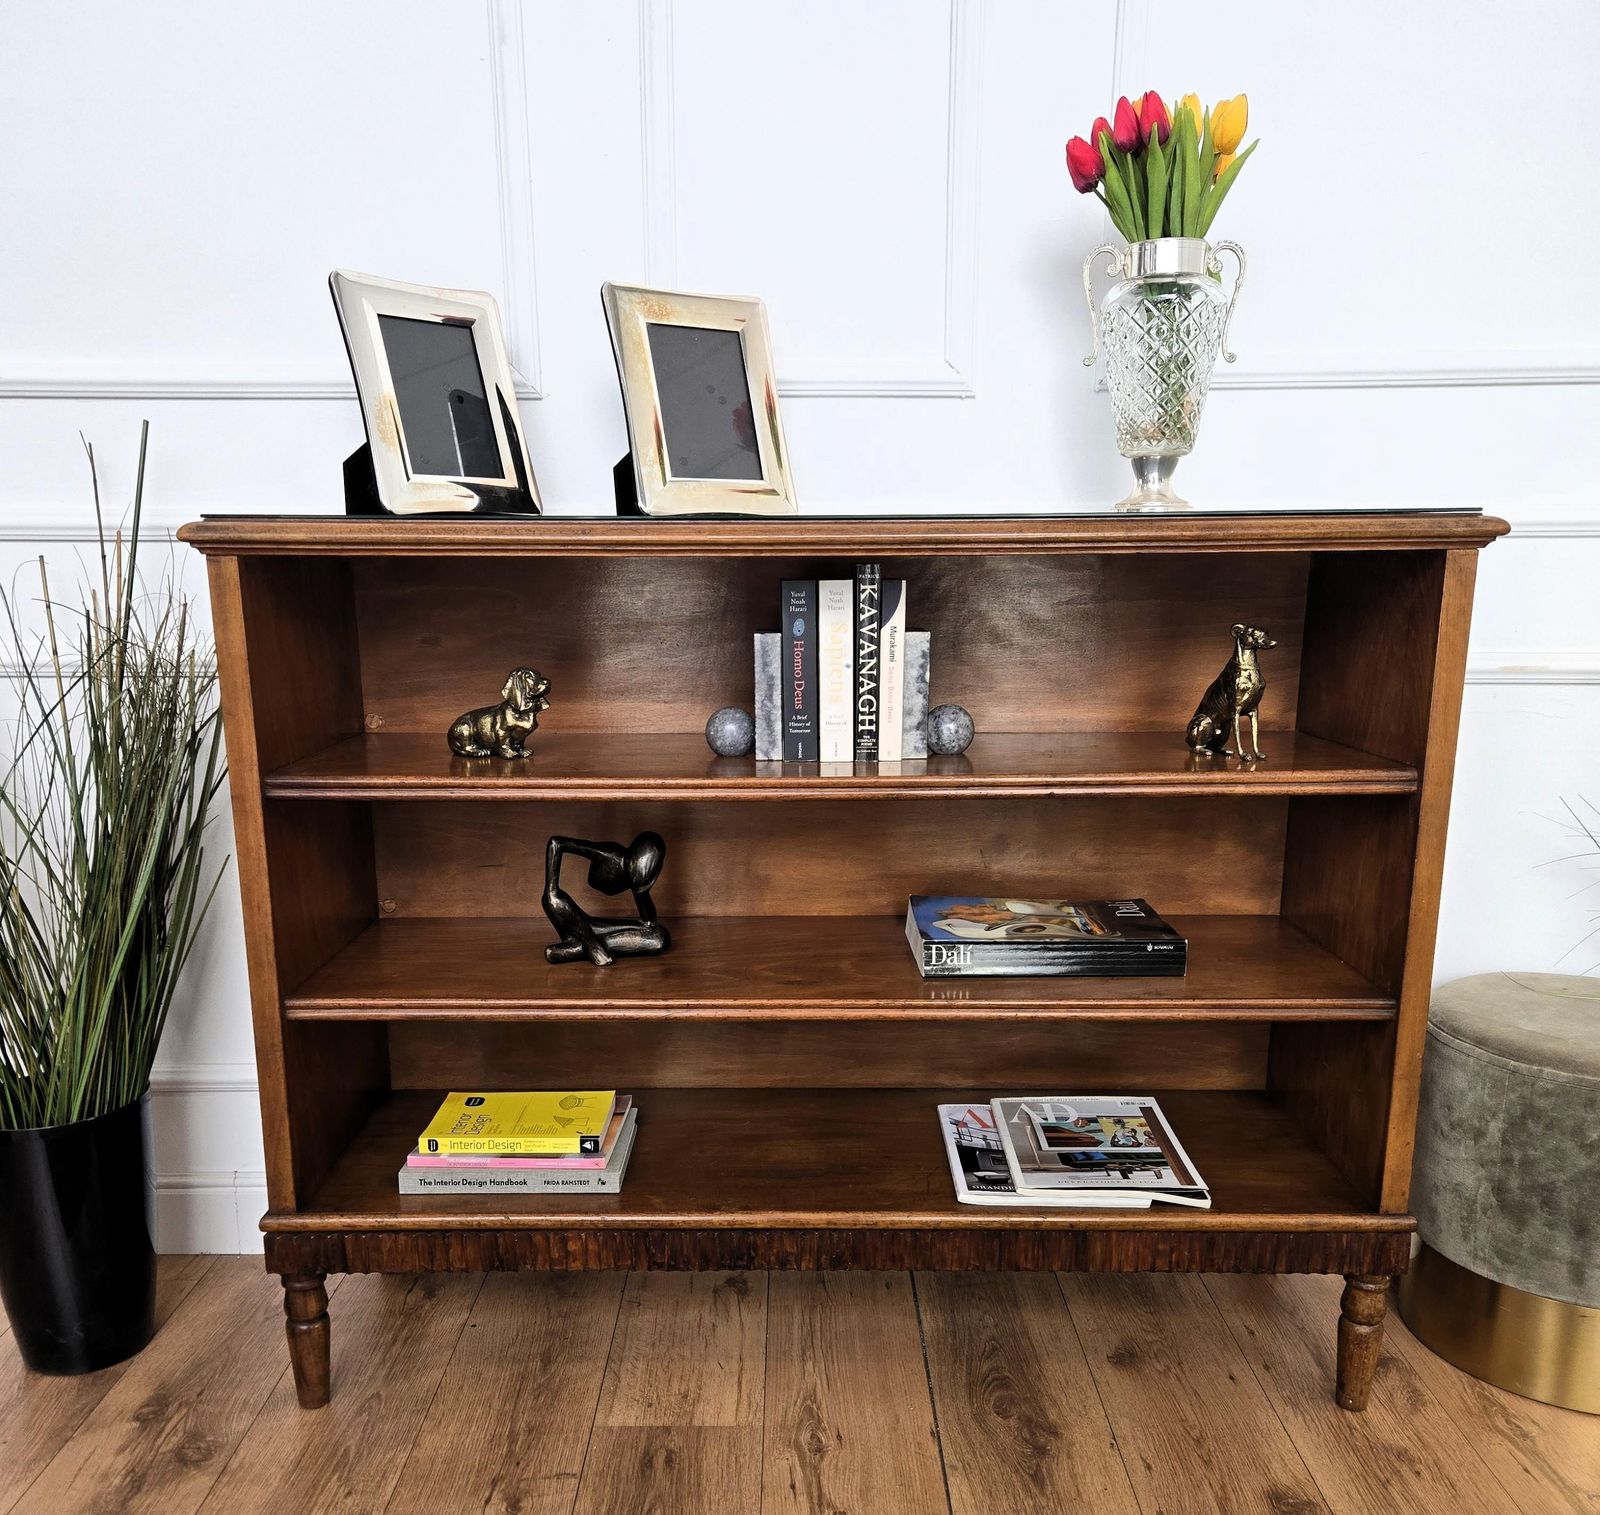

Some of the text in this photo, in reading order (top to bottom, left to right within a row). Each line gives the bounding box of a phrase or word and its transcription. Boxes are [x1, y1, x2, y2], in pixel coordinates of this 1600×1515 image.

[888, 625, 897, 663] Murakami
[858, 583, 878, 733] KAVANAGH
[793, 640, 805, 710] Homo Deus
[929, 945, 973, 965] Dalí
[1008, 1103, 1079, 1123] AD
[449, 1139, 486, 1150] Interior
[488, 1139, 522, 1152] Design
[434, 1178, 461, 1186] Interior
[462, 1178, 488, 1187] Design
[489, 1178, 528, 1186] Handbook
